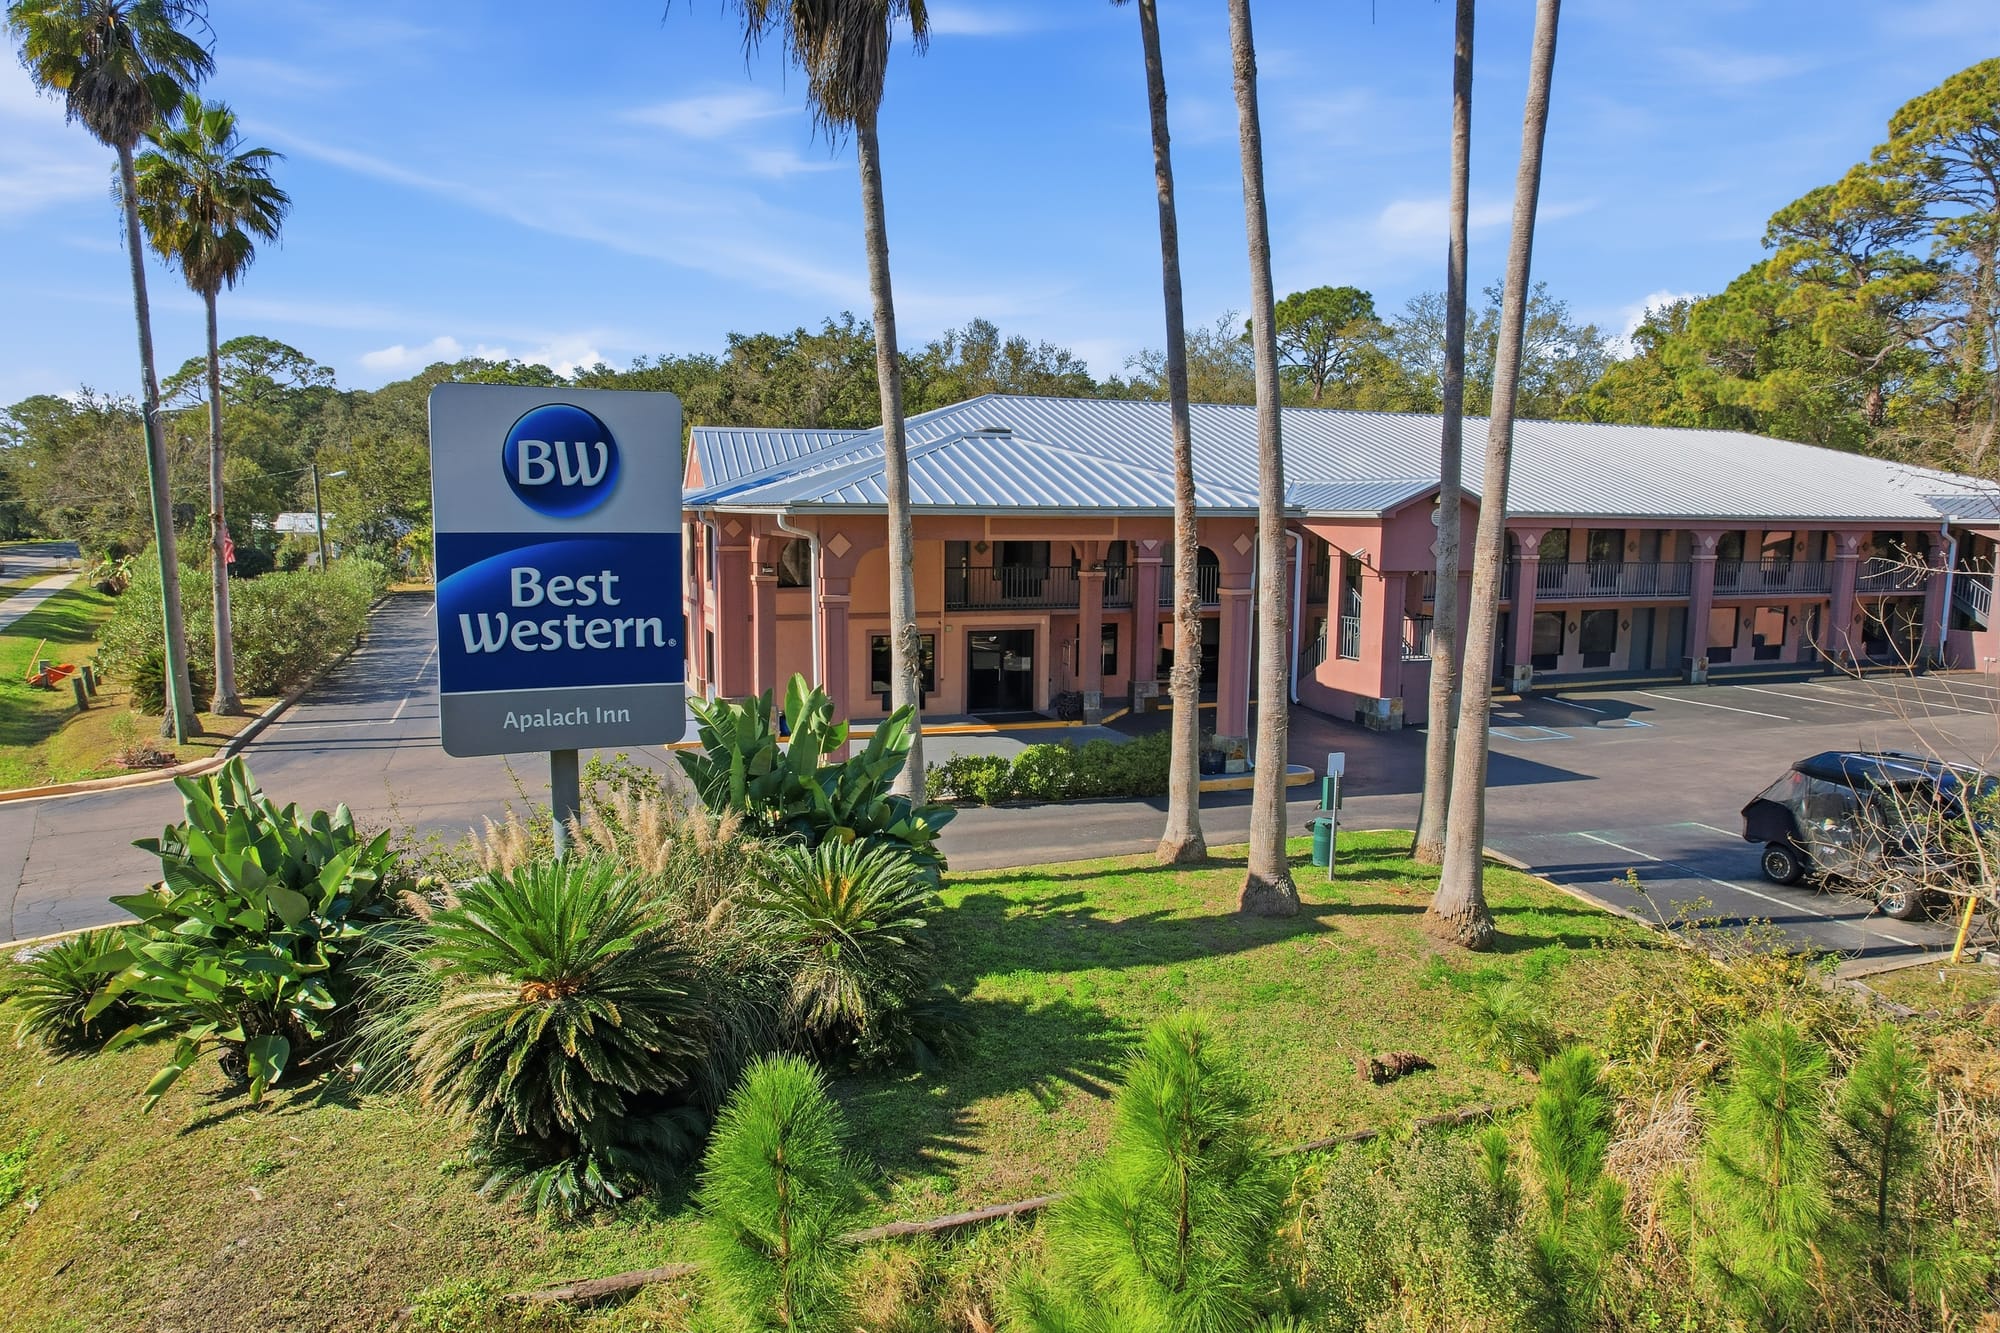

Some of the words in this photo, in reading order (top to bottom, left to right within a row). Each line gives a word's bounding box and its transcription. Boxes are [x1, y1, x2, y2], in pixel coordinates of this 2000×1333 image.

[518, 440, 608, 486] BW
[511, 567, 620, 607] Best
[458, 613, 666, 653] Western
[503, 707, 589, 731] Apalach
[596, 707, 630, 723] Inn
